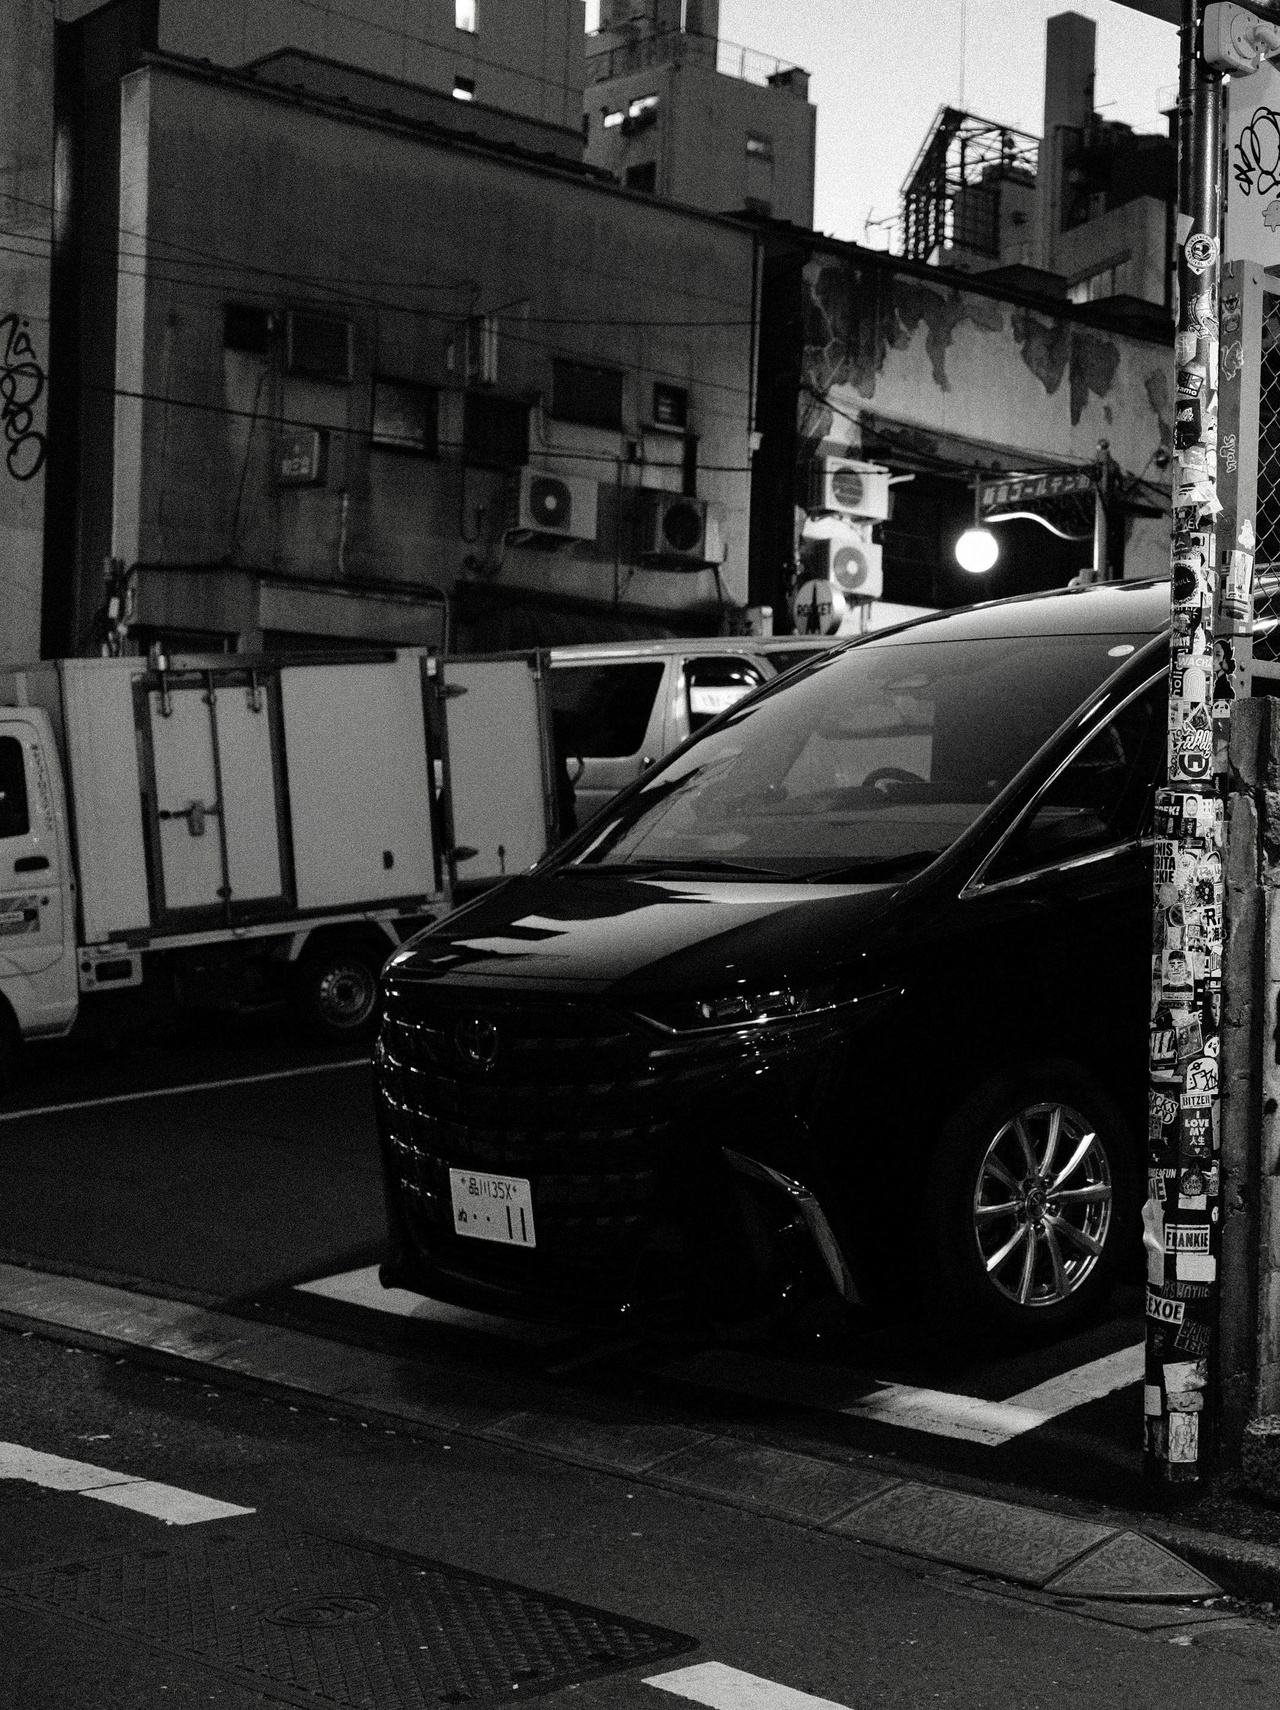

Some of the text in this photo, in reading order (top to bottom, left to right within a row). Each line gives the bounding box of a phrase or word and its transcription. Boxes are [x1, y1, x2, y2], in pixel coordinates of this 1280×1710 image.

[1182, 1096, 1210, 1106] BITZER
[1184, 1118, 1210, 1128] LOVE
[1189, 1128, 1206, 1136] MY
[1189, 1136, 1206, 1146] 人生
[1165, 1231, 1209, 1249] FRANKIE
